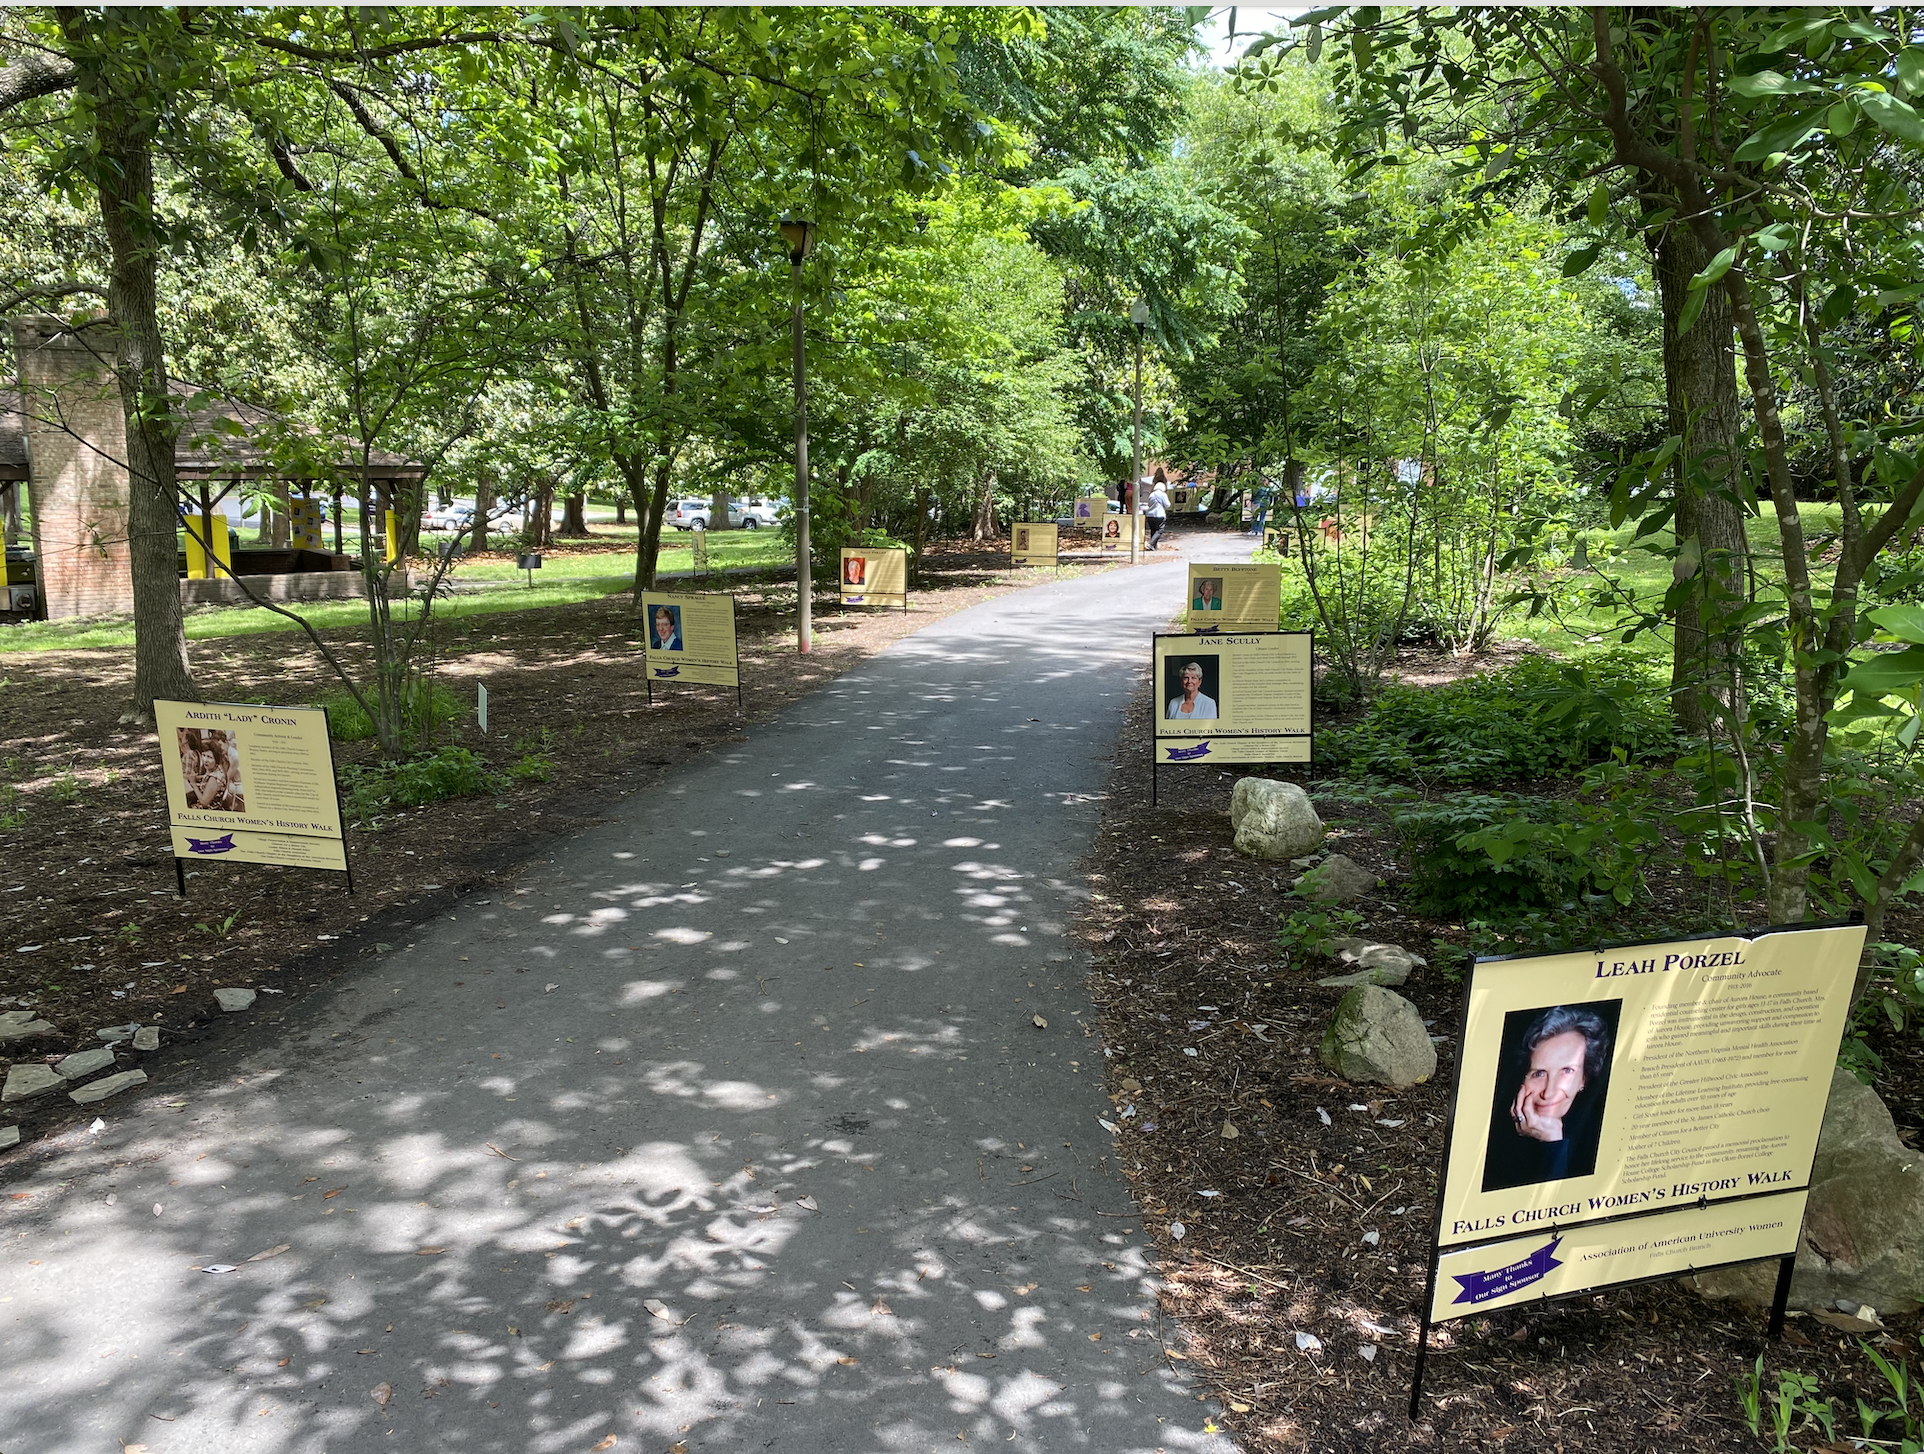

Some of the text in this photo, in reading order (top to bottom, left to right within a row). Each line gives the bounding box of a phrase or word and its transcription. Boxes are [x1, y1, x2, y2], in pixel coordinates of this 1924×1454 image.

[185, 710, 296, 726] ARDITH “LADY” CRONIN
[204, 814, 235, 823] CHURCH
[237, 816, 274, 826] WOMEN'S
[276, 820, 308, 829] HISTORY
[312, 823, 333, 832] WALK
[1595, 951, 1746, 980] LEAH PORZEL
[1701, 969, 1782, 982] Community Advocate
[1452, 1169, 1793, 1236] FALLS CHURCH WOMEN'S HISTORY WALK
[1579, 1218, 1784, 1262] Association of American University Women
[1482, 1258, 1533, 1284] Many Thanks
[1474, 1271, 1540, 1301] Our Sign Sponsor
